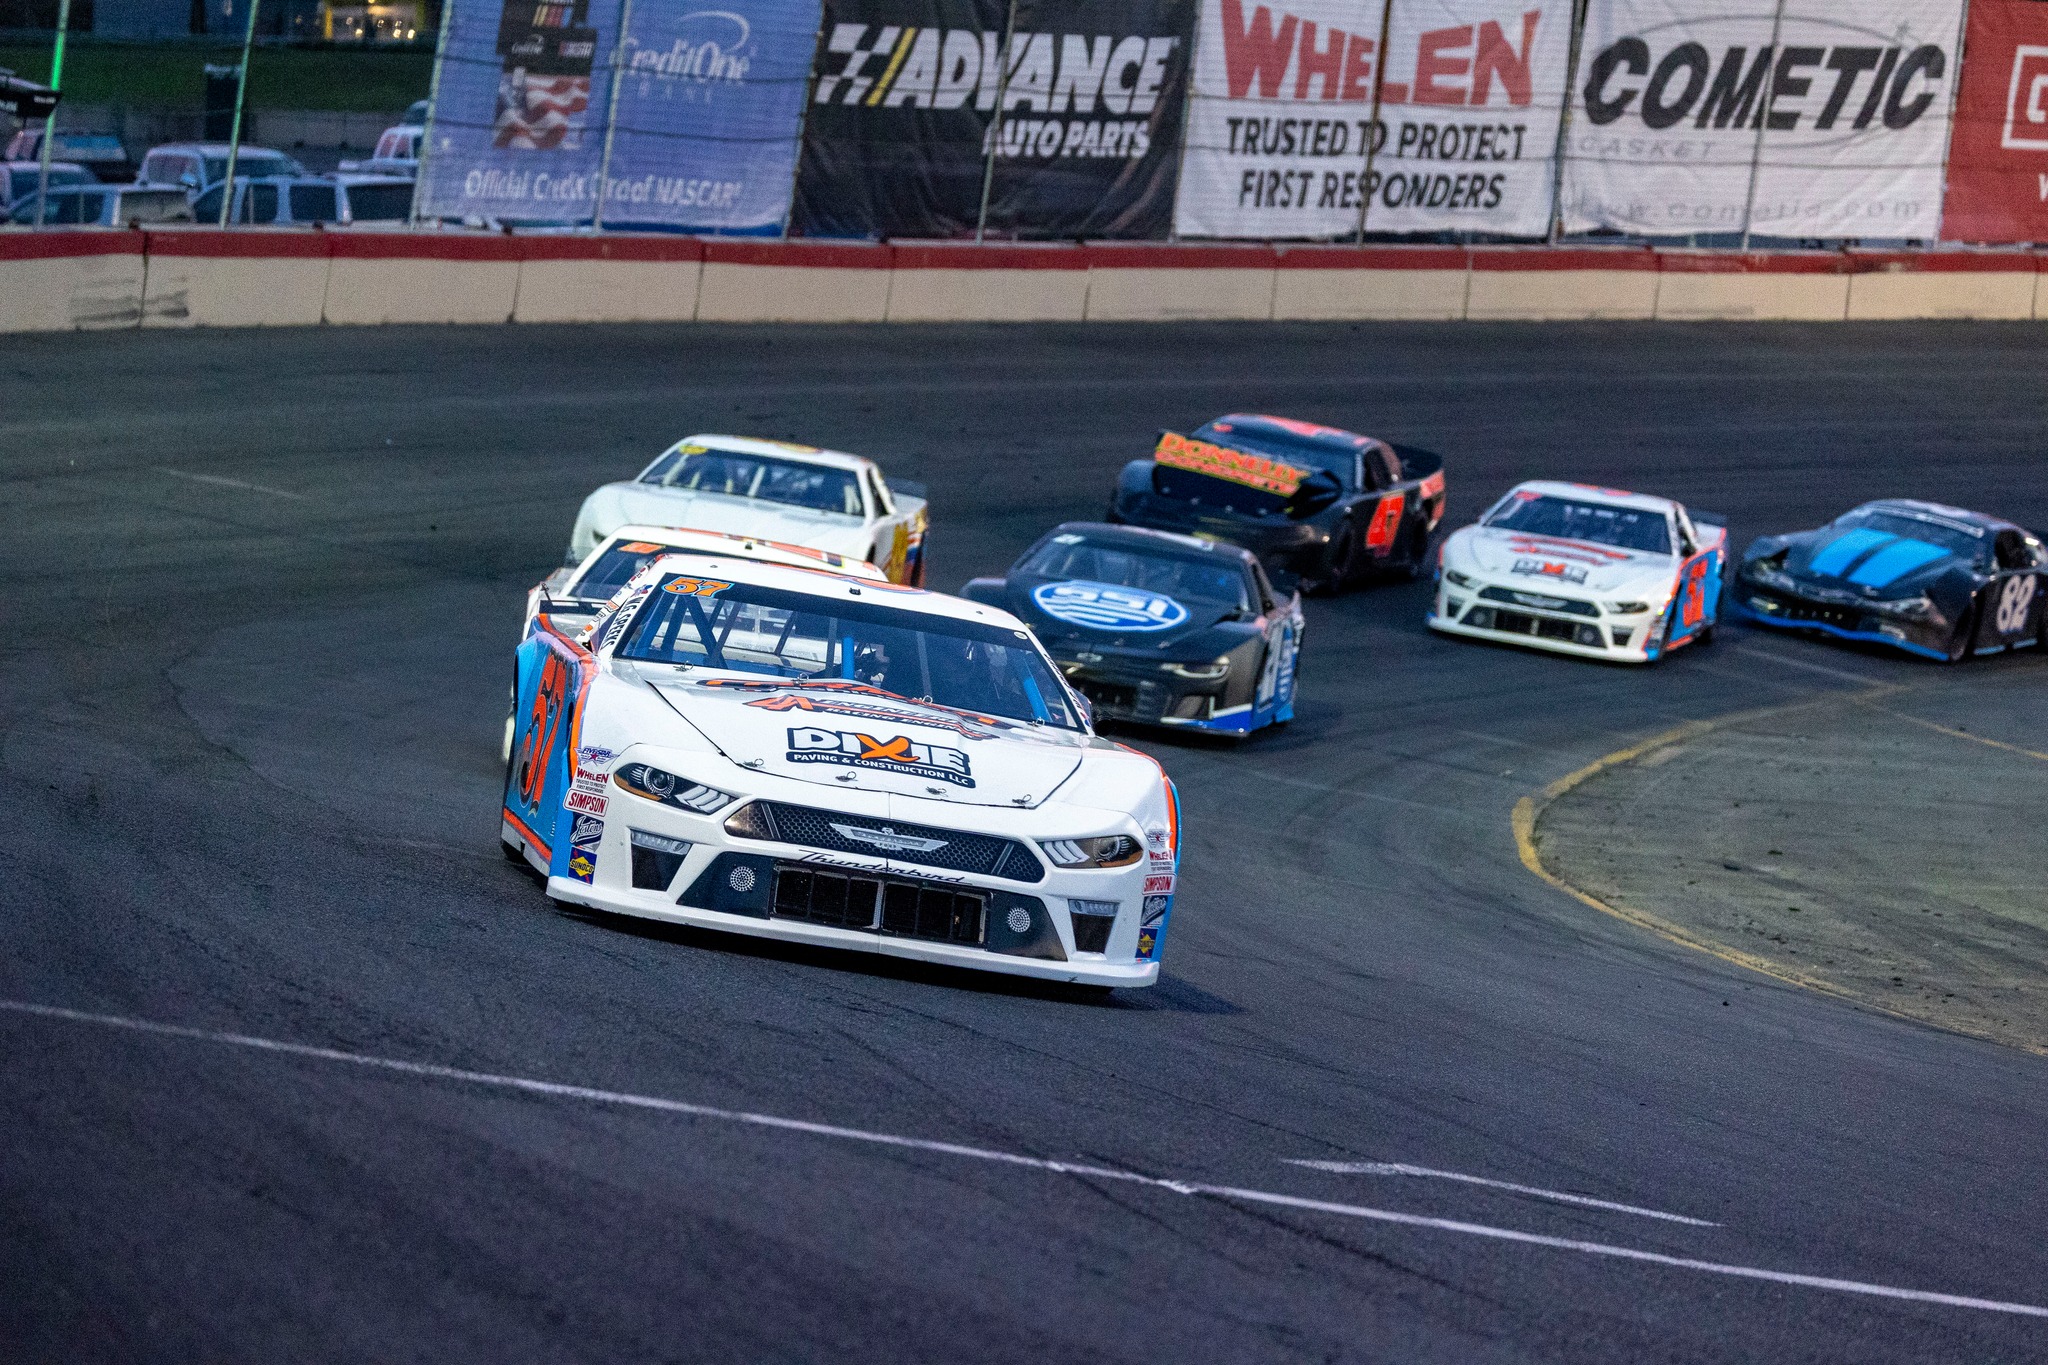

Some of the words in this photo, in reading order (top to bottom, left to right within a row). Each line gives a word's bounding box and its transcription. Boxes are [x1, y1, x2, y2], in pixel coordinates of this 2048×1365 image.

[884, 27, 1173, 114] ADVANCE
[1221, 0, 1541, 107] WHELEN
[1583, 37, 1946, 131] COMETIC
[981, 119, 1062, 157] AUTO
[1061, 121, 1150, 158] PARTS
[1226, 117, 1349, 156] TRUSTED
[1357, 120, 1388, 156] TO
[1399, 121, 1526, 161] PROTECT
[1239, 169, 1313, 208] FIRST
[1317, 170, 1505, 209] RESPONDERS
[662, 576, 735, 598] 57
[1997, 574, 2037, 632] 82
[519, 651, 567, 815] 57
[787, 726, 971, 776] DIXIE
[577, 766, 609, 784] WHELEN
[793, 753, 838, 764] PAVING
[841, 756, 851, 764] &
[854, 758, 946, 779] CONSTRUCTION
[948, 774, 969, 786] LLC
[569, 791, 606, 814] SIMPSON
[570, 816, 603, 843] Jostens
[570, 859, 595, 874] SUNOCO
[799, 850, 973, 885] Thunderbird
[1144, 876, 1172, 892] SIMPSON
